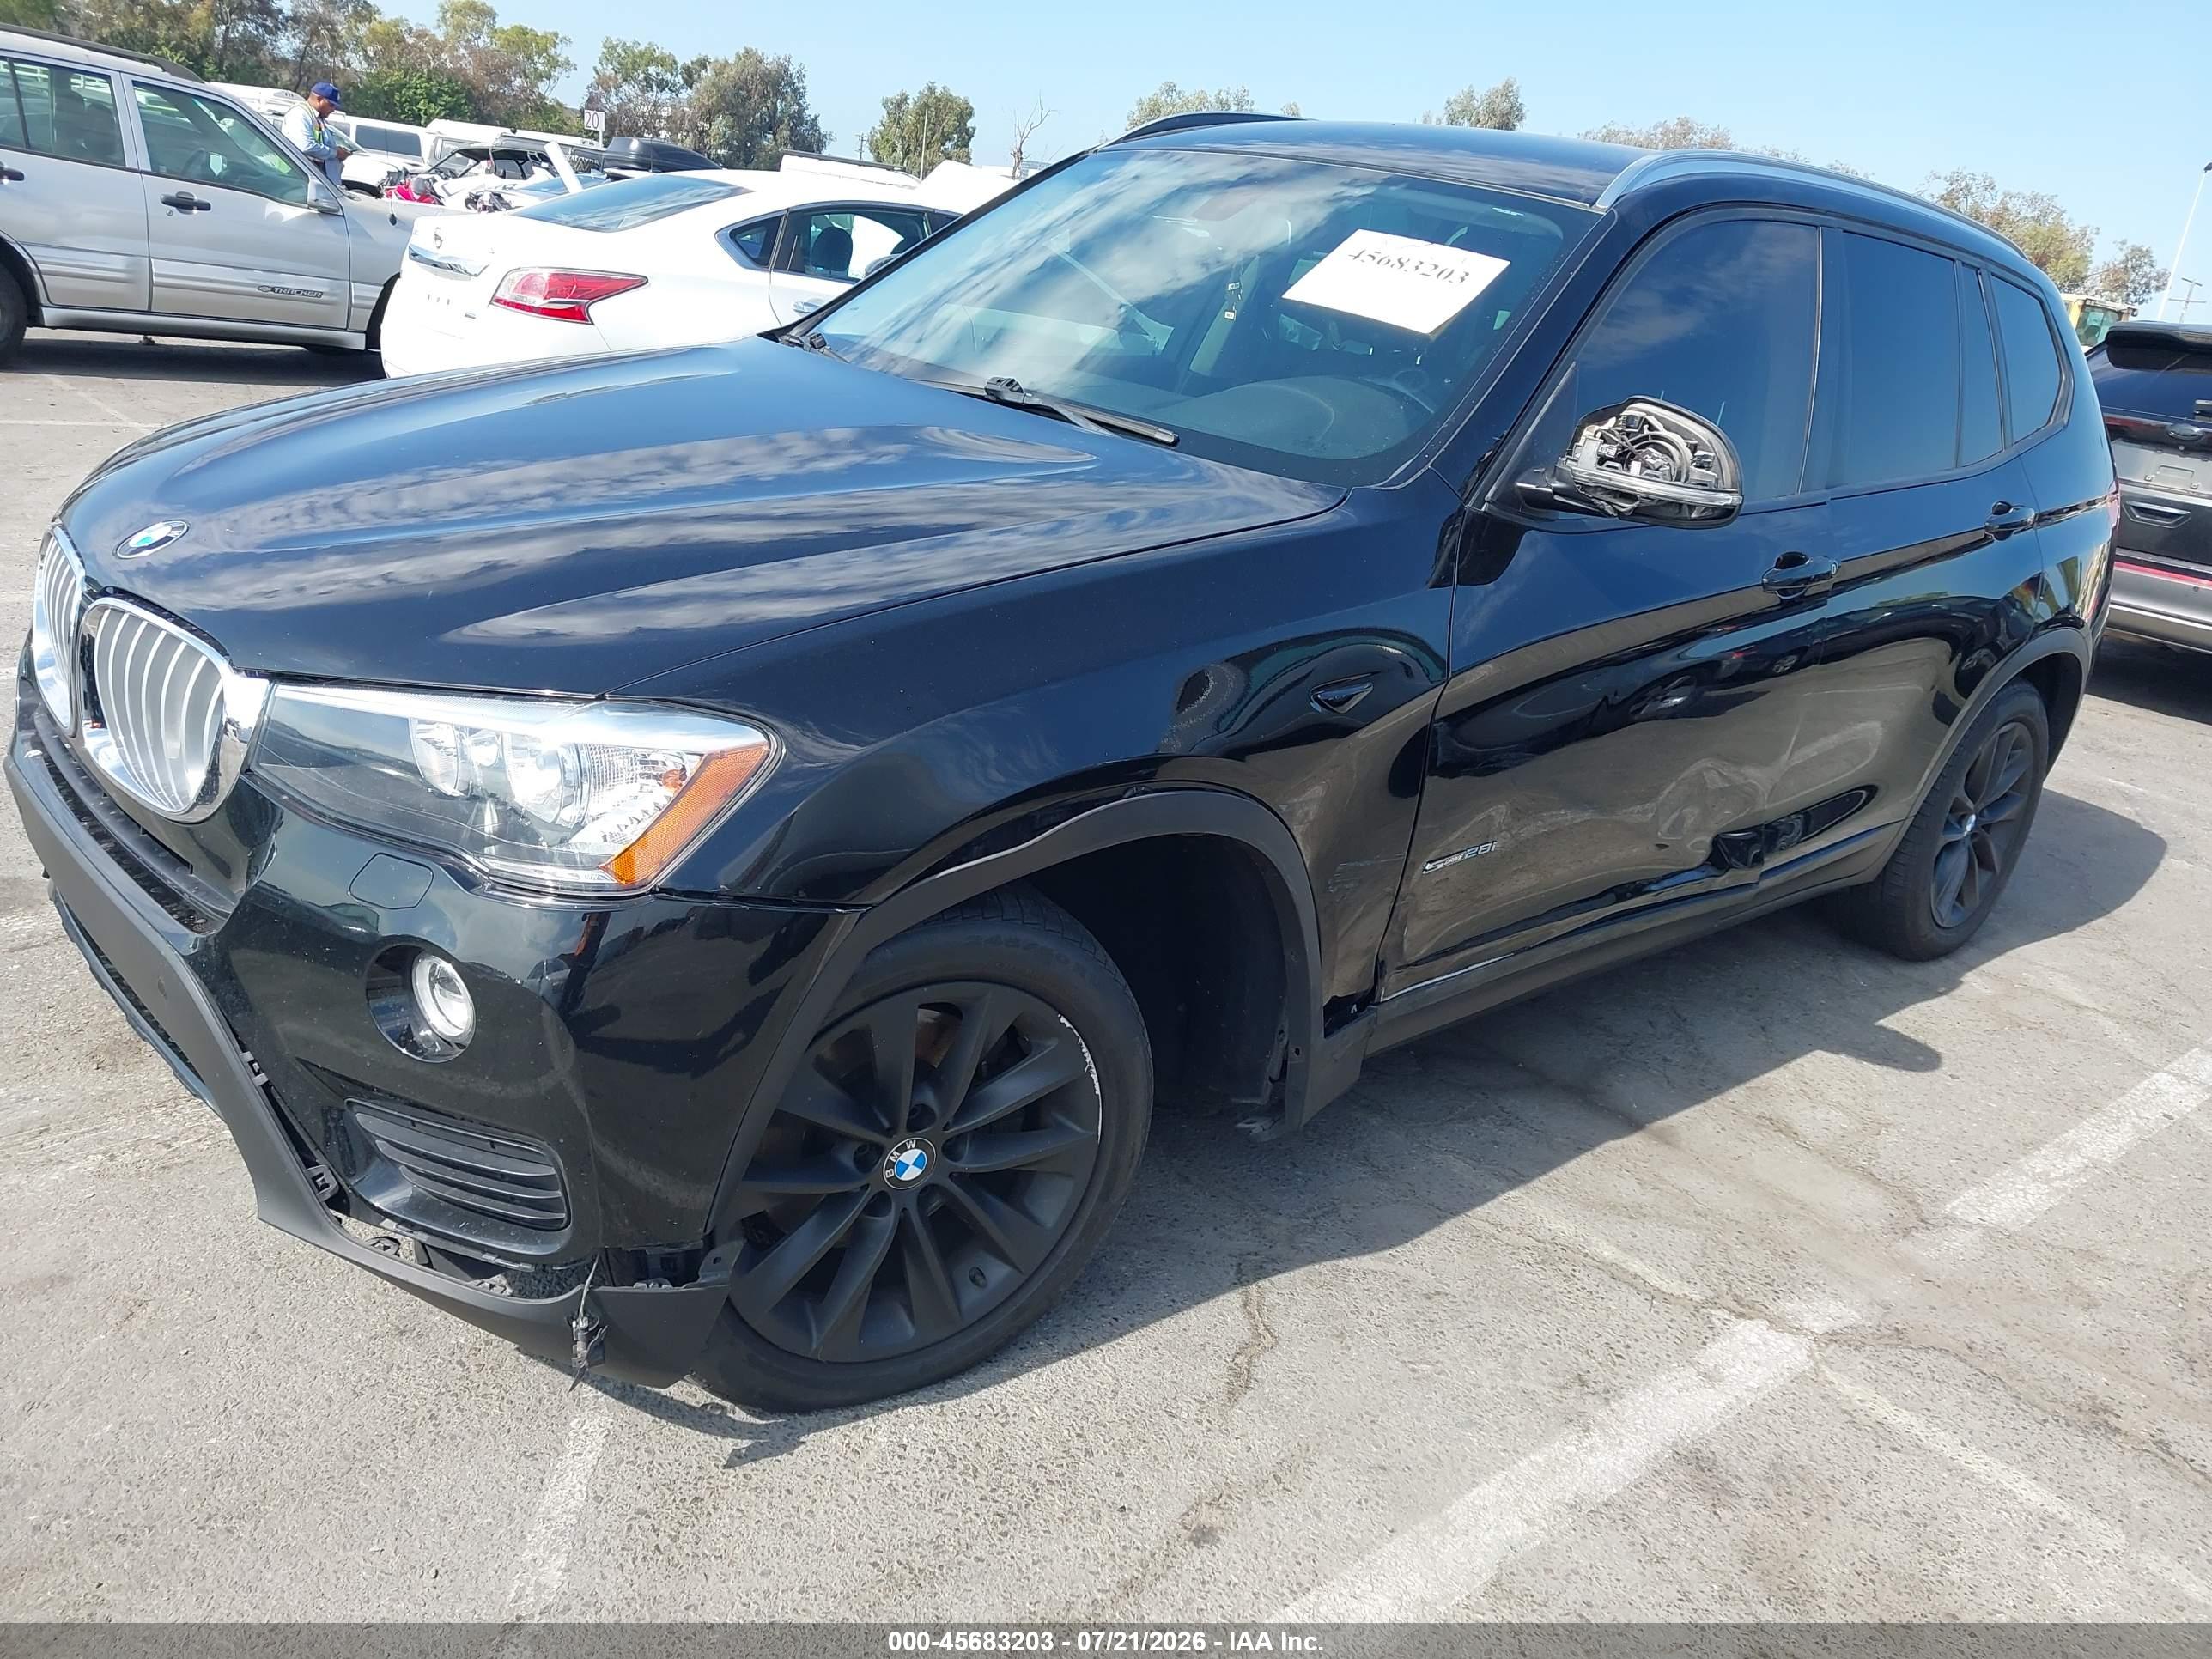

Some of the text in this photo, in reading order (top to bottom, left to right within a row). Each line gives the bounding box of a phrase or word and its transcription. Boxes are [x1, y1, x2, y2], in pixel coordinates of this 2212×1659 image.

[585, 112, 599, 130] 20
[1348, 250, 1469, 283] 45683203
[274, 287, 322, 298] TRACKER
